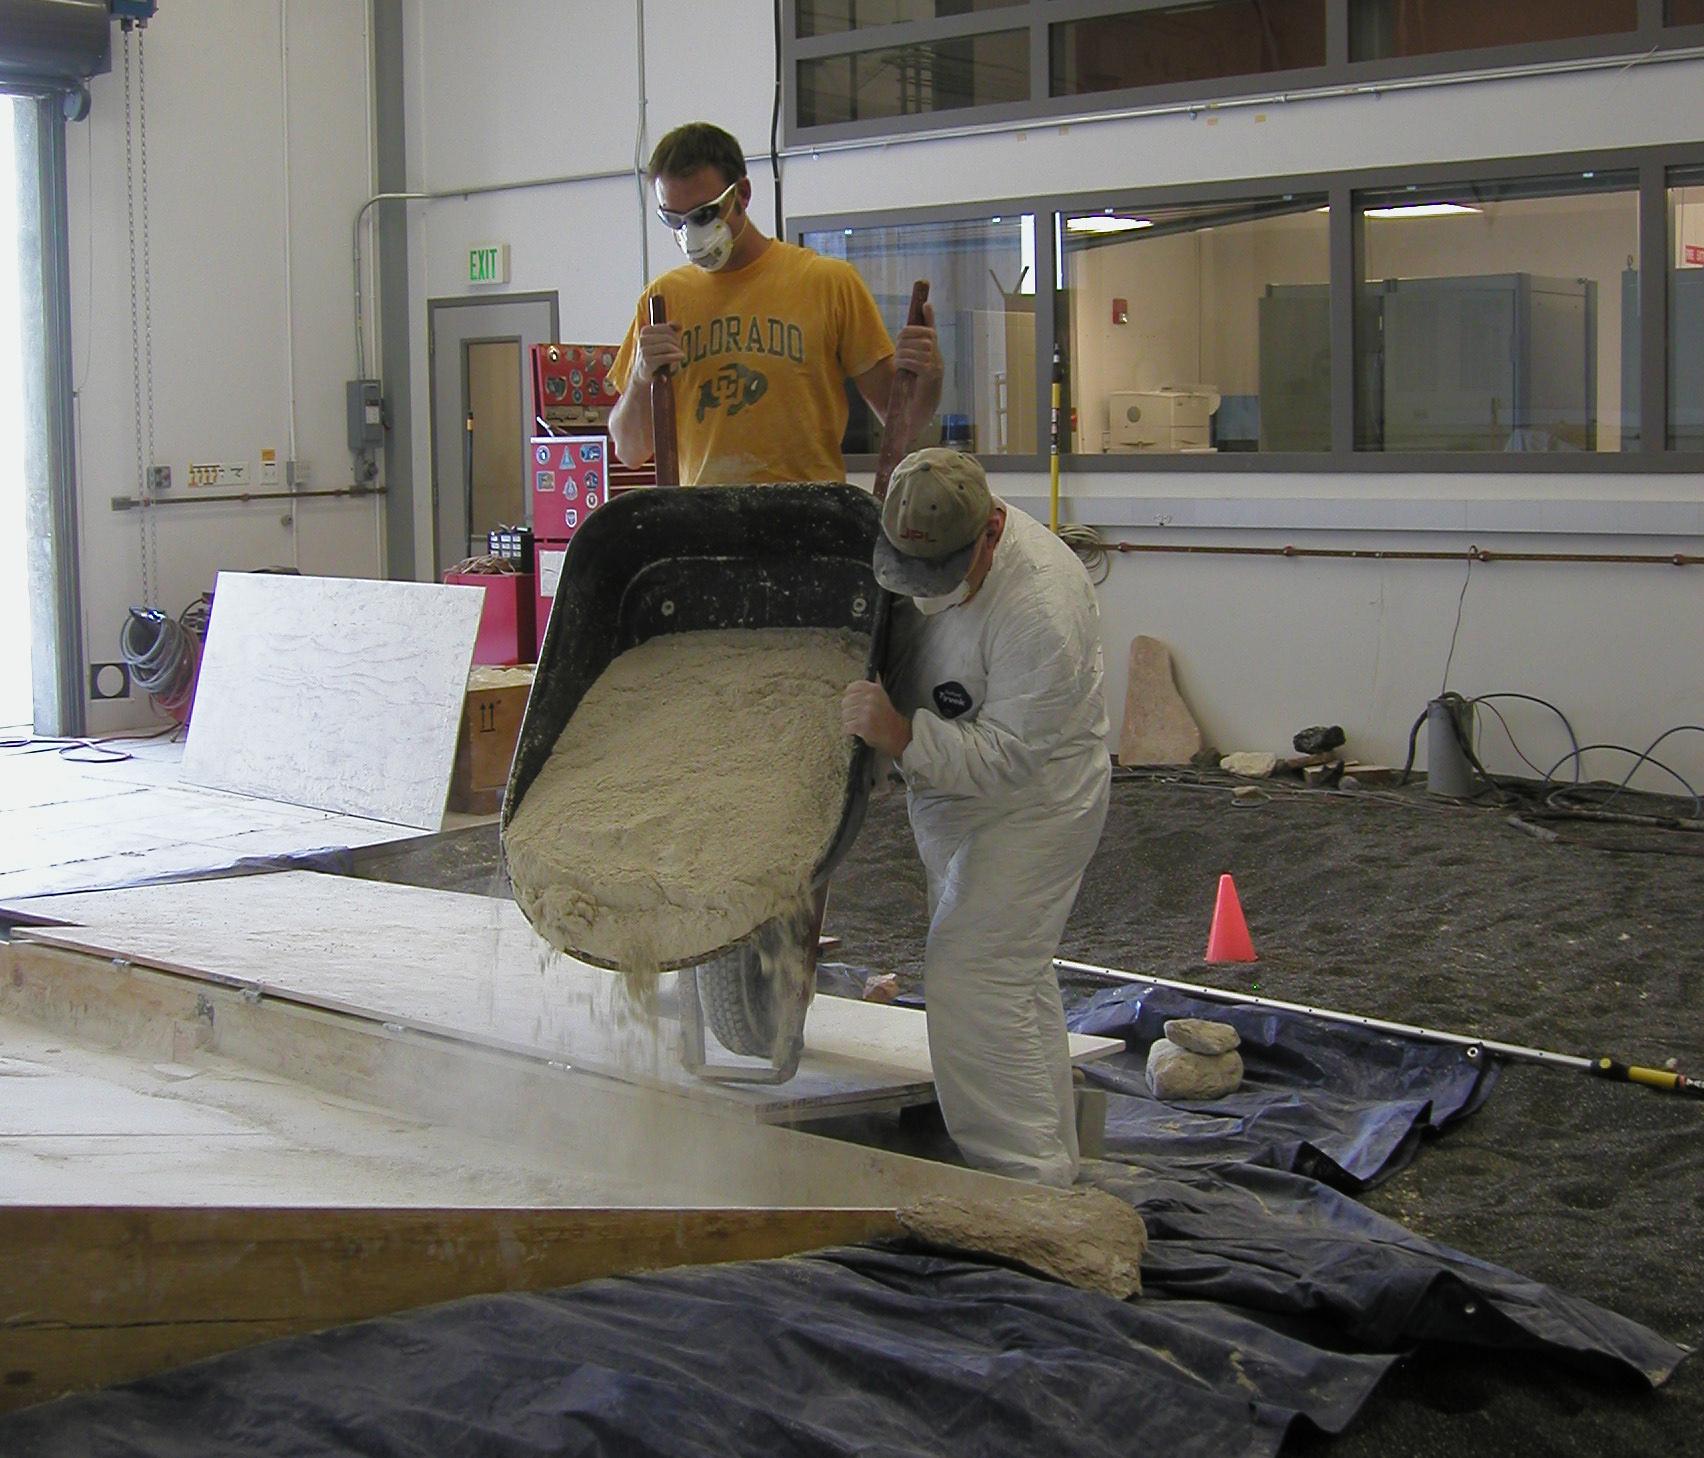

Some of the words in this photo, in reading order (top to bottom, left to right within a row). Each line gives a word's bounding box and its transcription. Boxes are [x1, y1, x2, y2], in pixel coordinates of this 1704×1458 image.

[469, 248, 498, 281] EXIT
[671, 314, 805, 375] OLORADO
[899, 527, 937, 545] JPL
